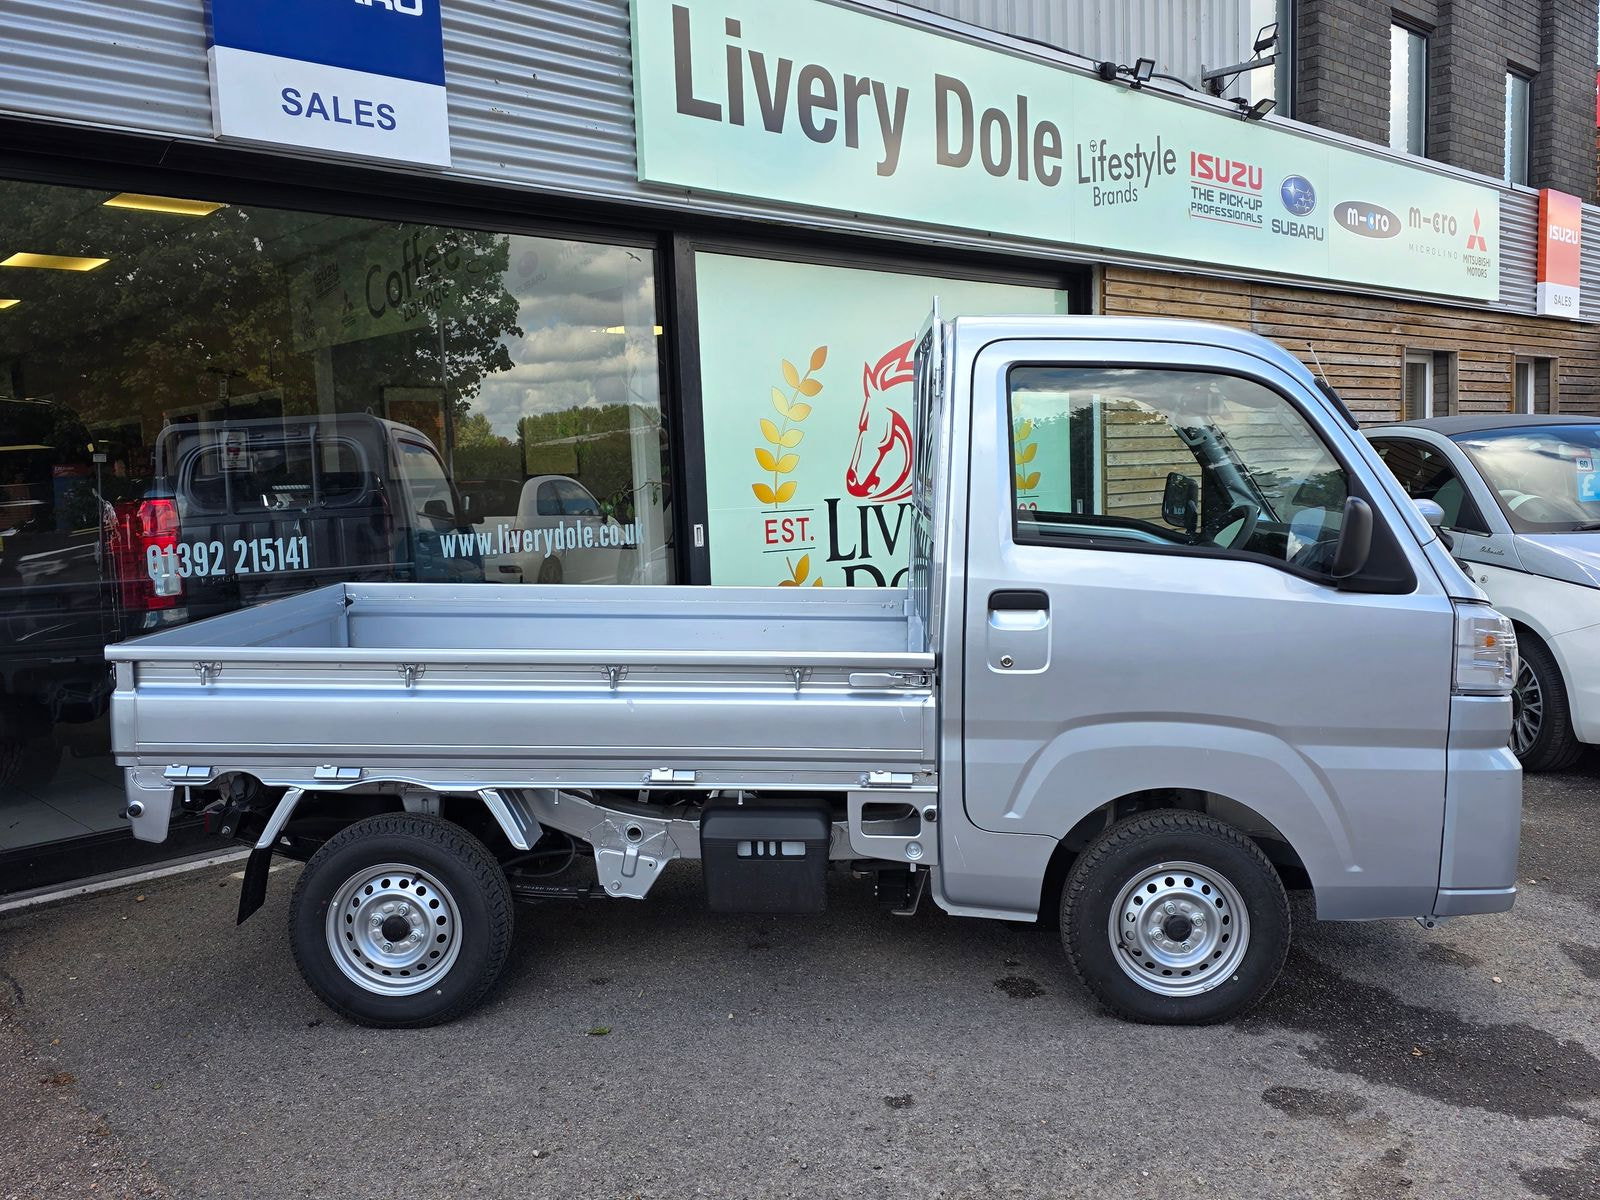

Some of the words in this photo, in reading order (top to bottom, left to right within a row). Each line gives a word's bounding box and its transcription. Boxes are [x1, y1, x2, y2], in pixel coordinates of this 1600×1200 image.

[671, 3, 910, 178] Livery
[934, 73, 1063, 187] Dole
[281, 87, 397, 131] SALES
[1077, 135, 1177, 188] Lifestyle
[1190, 151, 1263, 191] ISUZU
[1093, 182, 1138, 207] Brands
[1191, 186, 1215, 203] THE
[1219, 192, 1263, 212] PICK-UP
[1191, 202, 1263, 224] PROFESSIONALS
[1271, 218, 1324, 242] SUBARU
[1549, 224, 1579, 245] ISUZU
[1408, 243, 1458, 260] MICROLINO
[1463, 254, 1491, 268] MITSUBISHI
[1467, 266, 1488, 279] MOTORS
[1553, 294, 1572, 308] SALES
[439, 516, 645, 559] www.liverydole.co.uk
[764, 517, 815, 545] EST.
[823, 498, 914, 562] LIV
[146, 540, 226, 580] 01392
[233, 535, 310, 575] 215141
